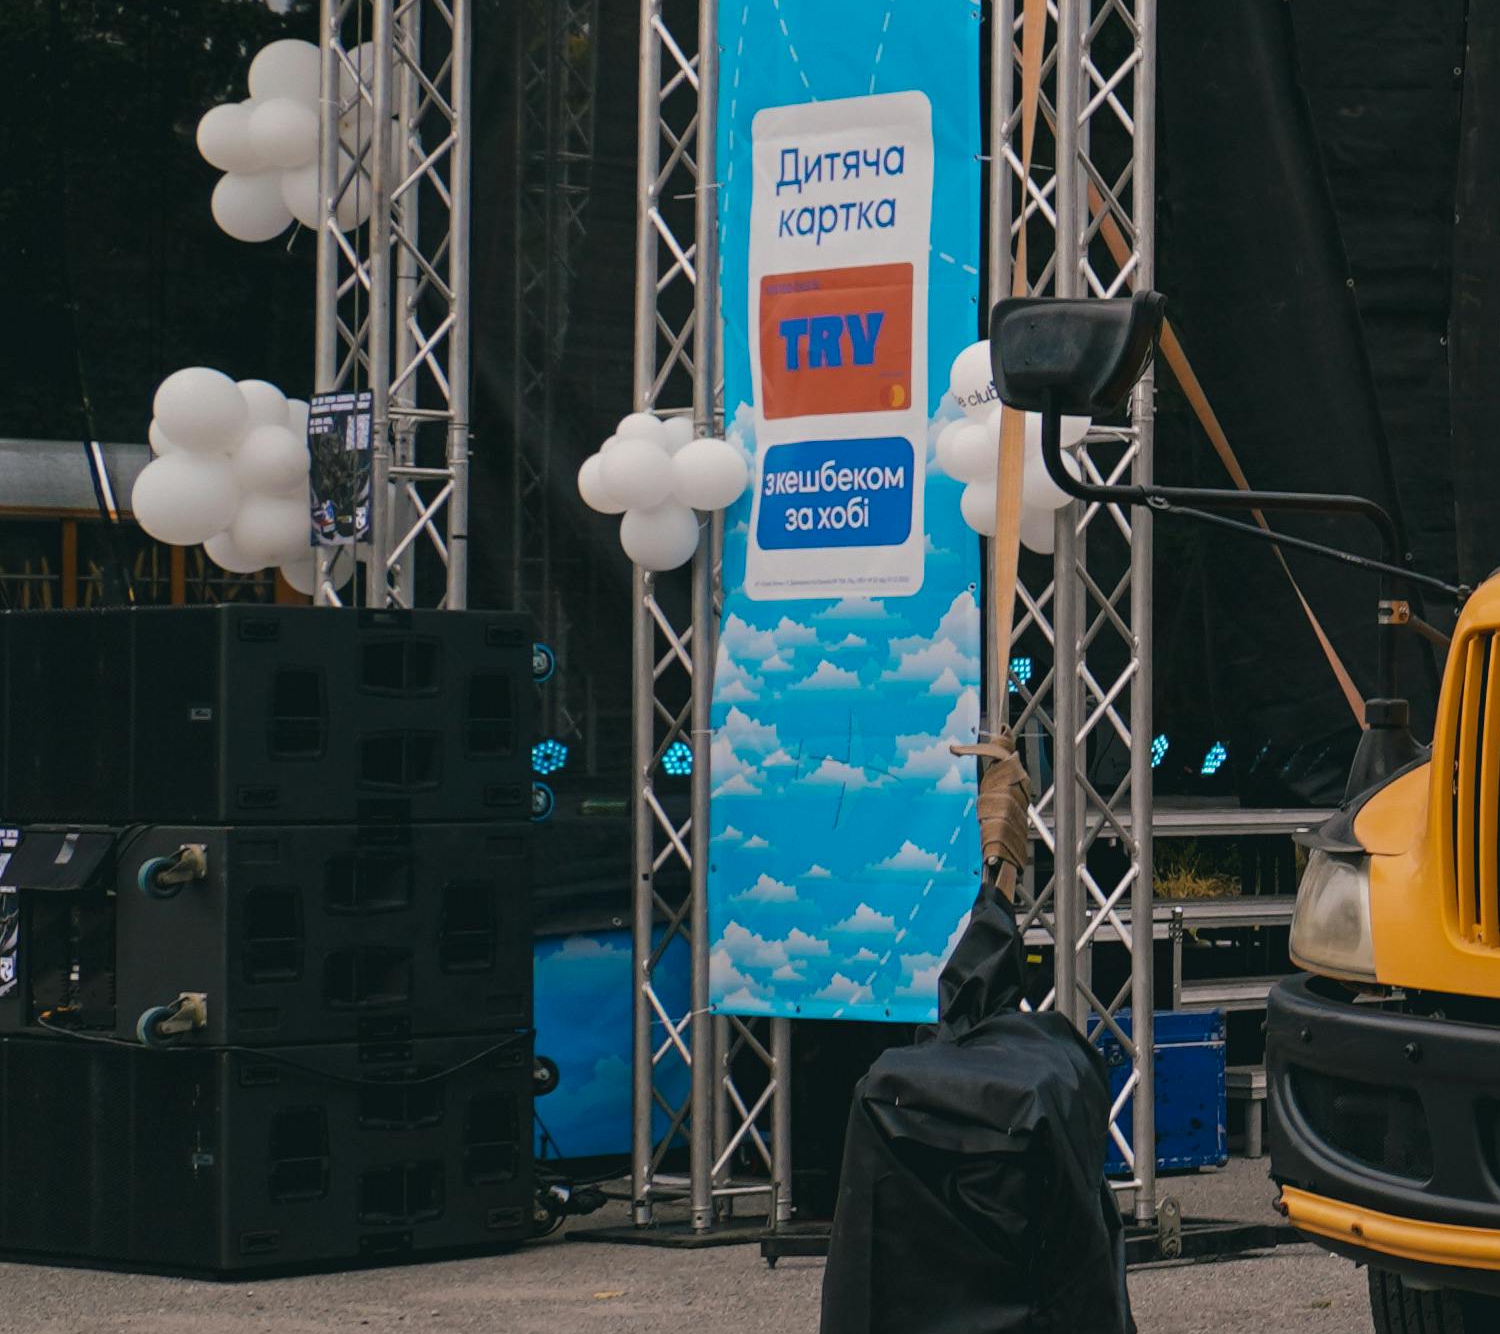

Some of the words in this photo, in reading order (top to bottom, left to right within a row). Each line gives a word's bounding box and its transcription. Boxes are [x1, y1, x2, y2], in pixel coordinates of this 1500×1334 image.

[776, 145, 905, 196] Дитяча
[778, 198, 896, 245] картка
[785, 507, 813, 531] за
[818, 496, 869, 530] хобі
